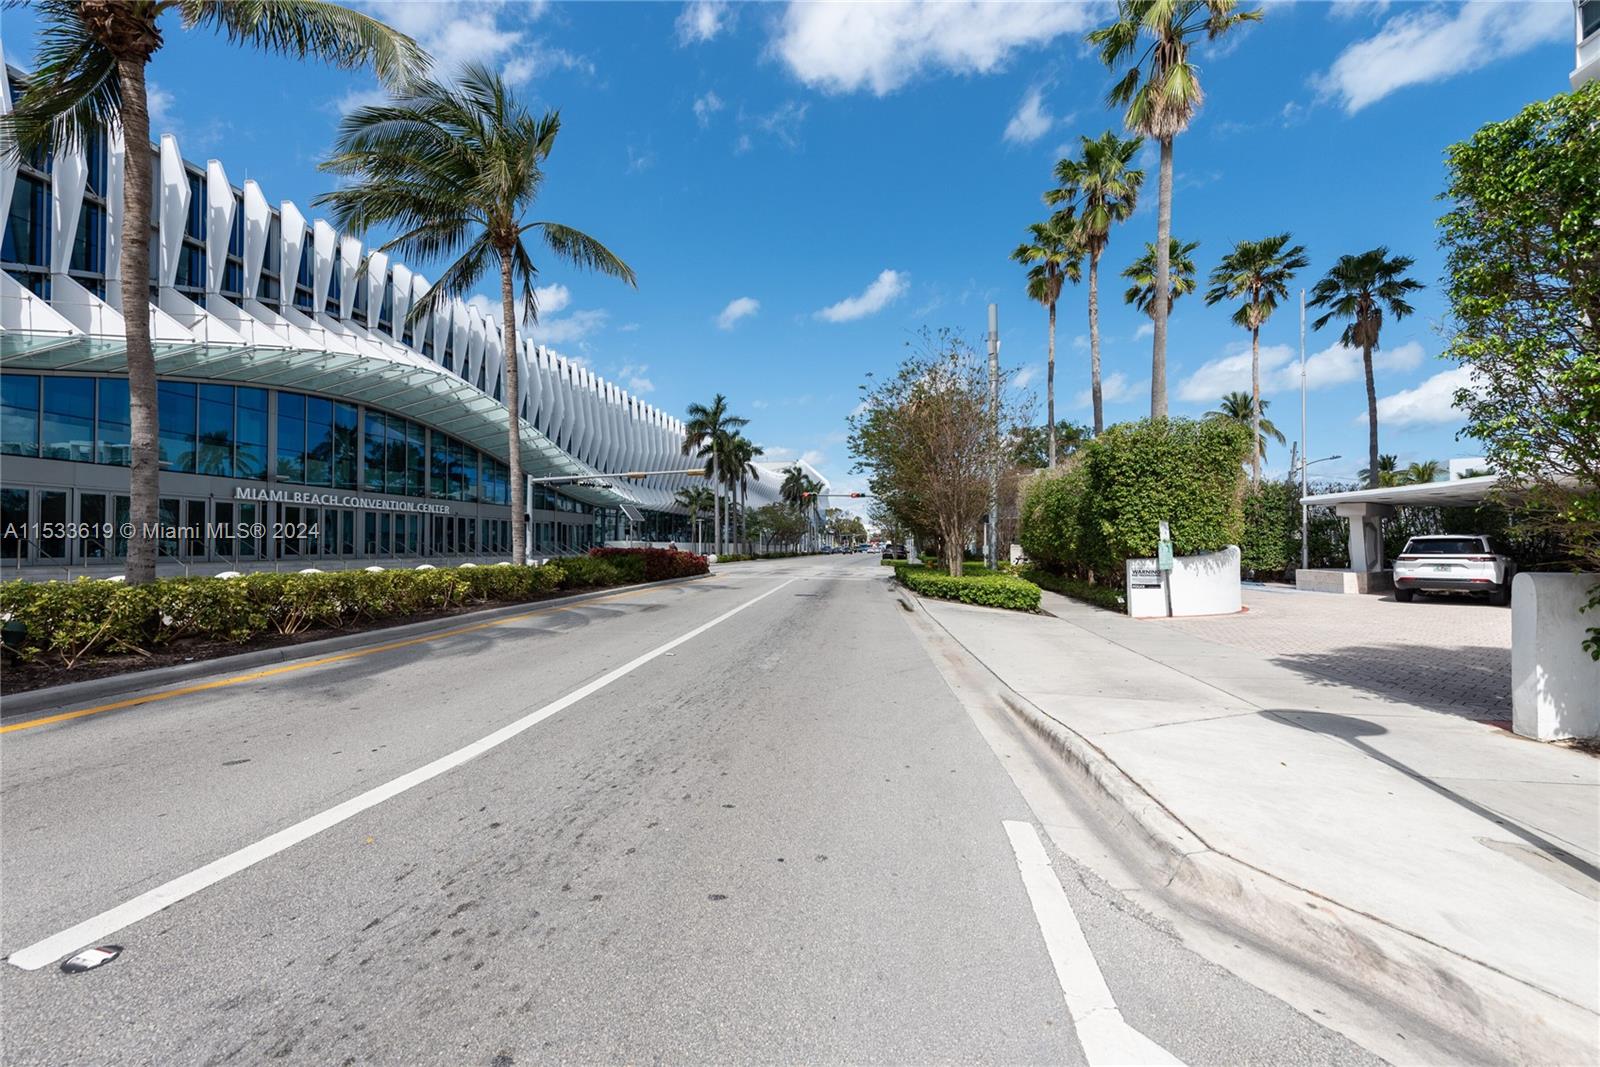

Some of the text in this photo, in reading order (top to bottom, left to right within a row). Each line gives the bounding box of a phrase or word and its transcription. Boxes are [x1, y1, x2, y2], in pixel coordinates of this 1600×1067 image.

[235, 487, 450, 514] MIAMI BEACH CONVENTION CENTER
